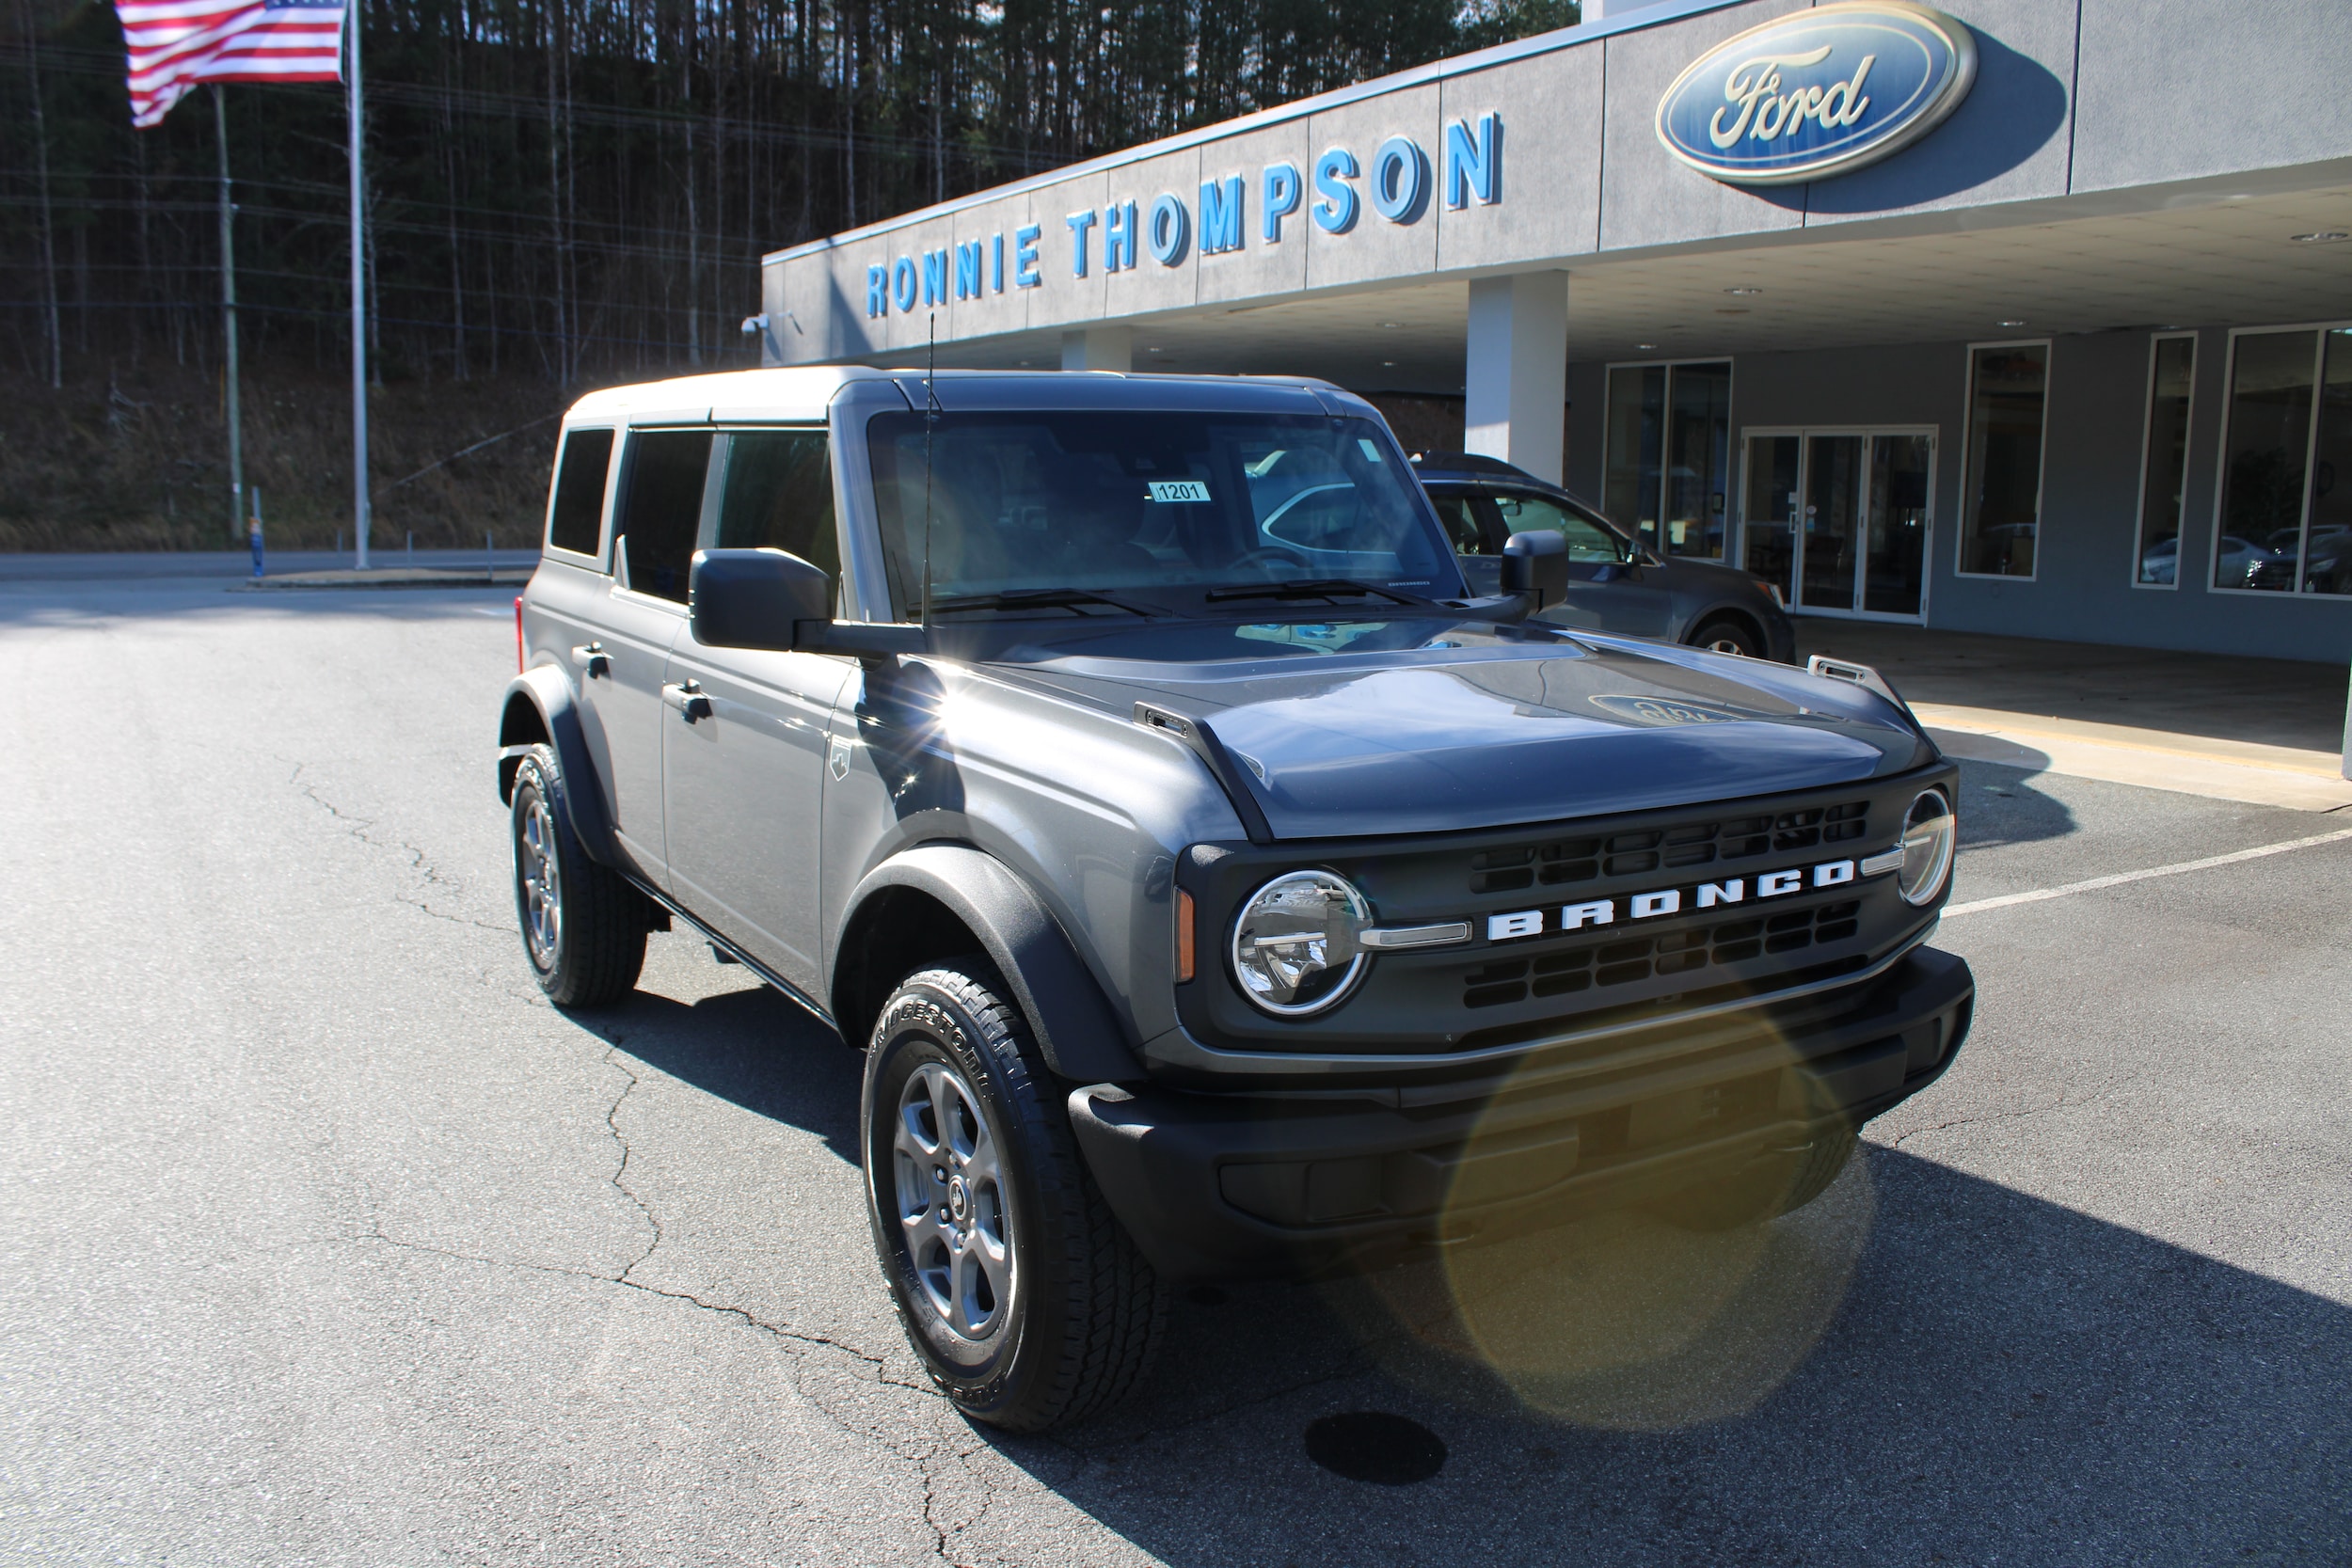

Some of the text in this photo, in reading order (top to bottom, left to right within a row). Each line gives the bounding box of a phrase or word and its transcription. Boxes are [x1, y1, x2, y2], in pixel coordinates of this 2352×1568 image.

[1708, 44, 1878, 150] Ford
[866, 111, 1503, 319] RONNIE THOMPSON
[1159, 483, 1200, 499] 1201
[1486, 859, 1855, 942] BRONCO
